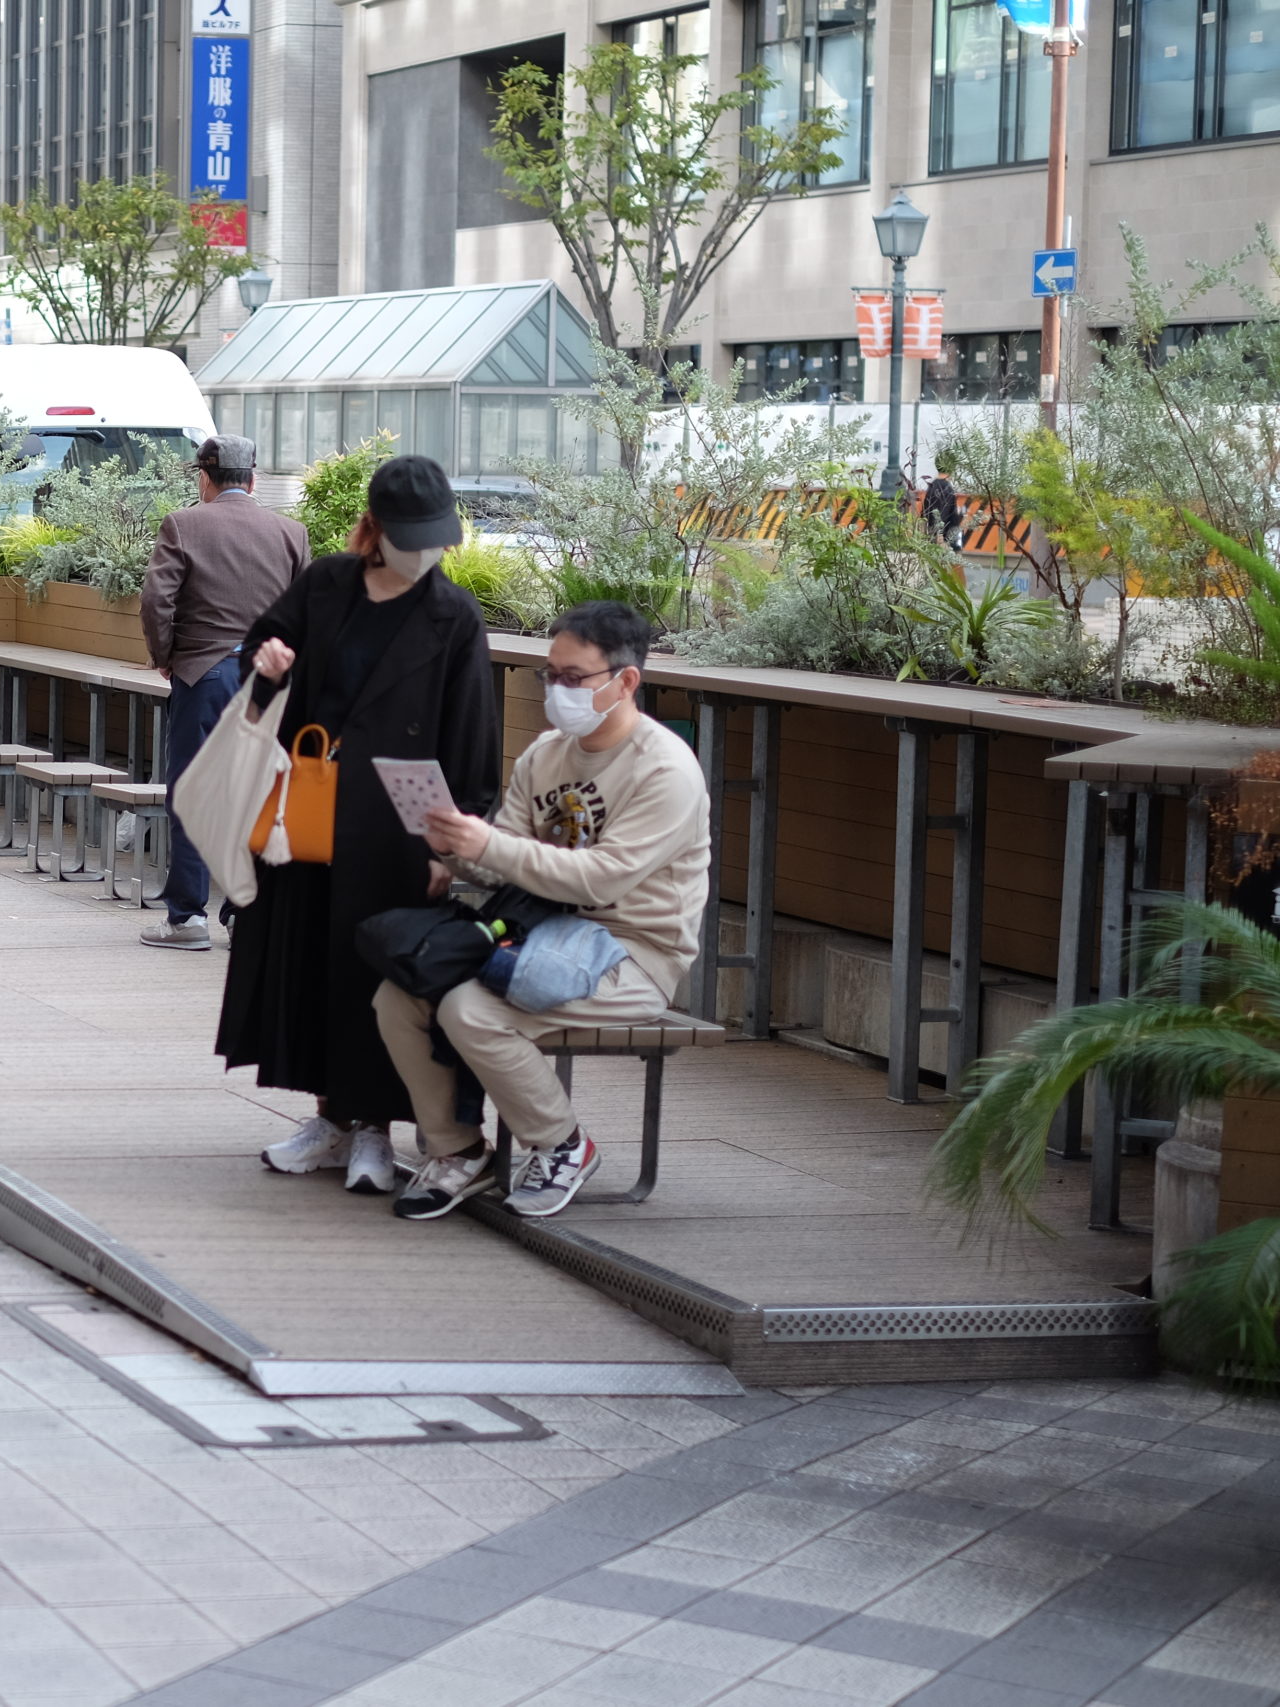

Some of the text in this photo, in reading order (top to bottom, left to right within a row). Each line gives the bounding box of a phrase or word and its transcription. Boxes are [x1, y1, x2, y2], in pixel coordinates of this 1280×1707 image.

[206, 45, 233, 181] 洋服の青山
